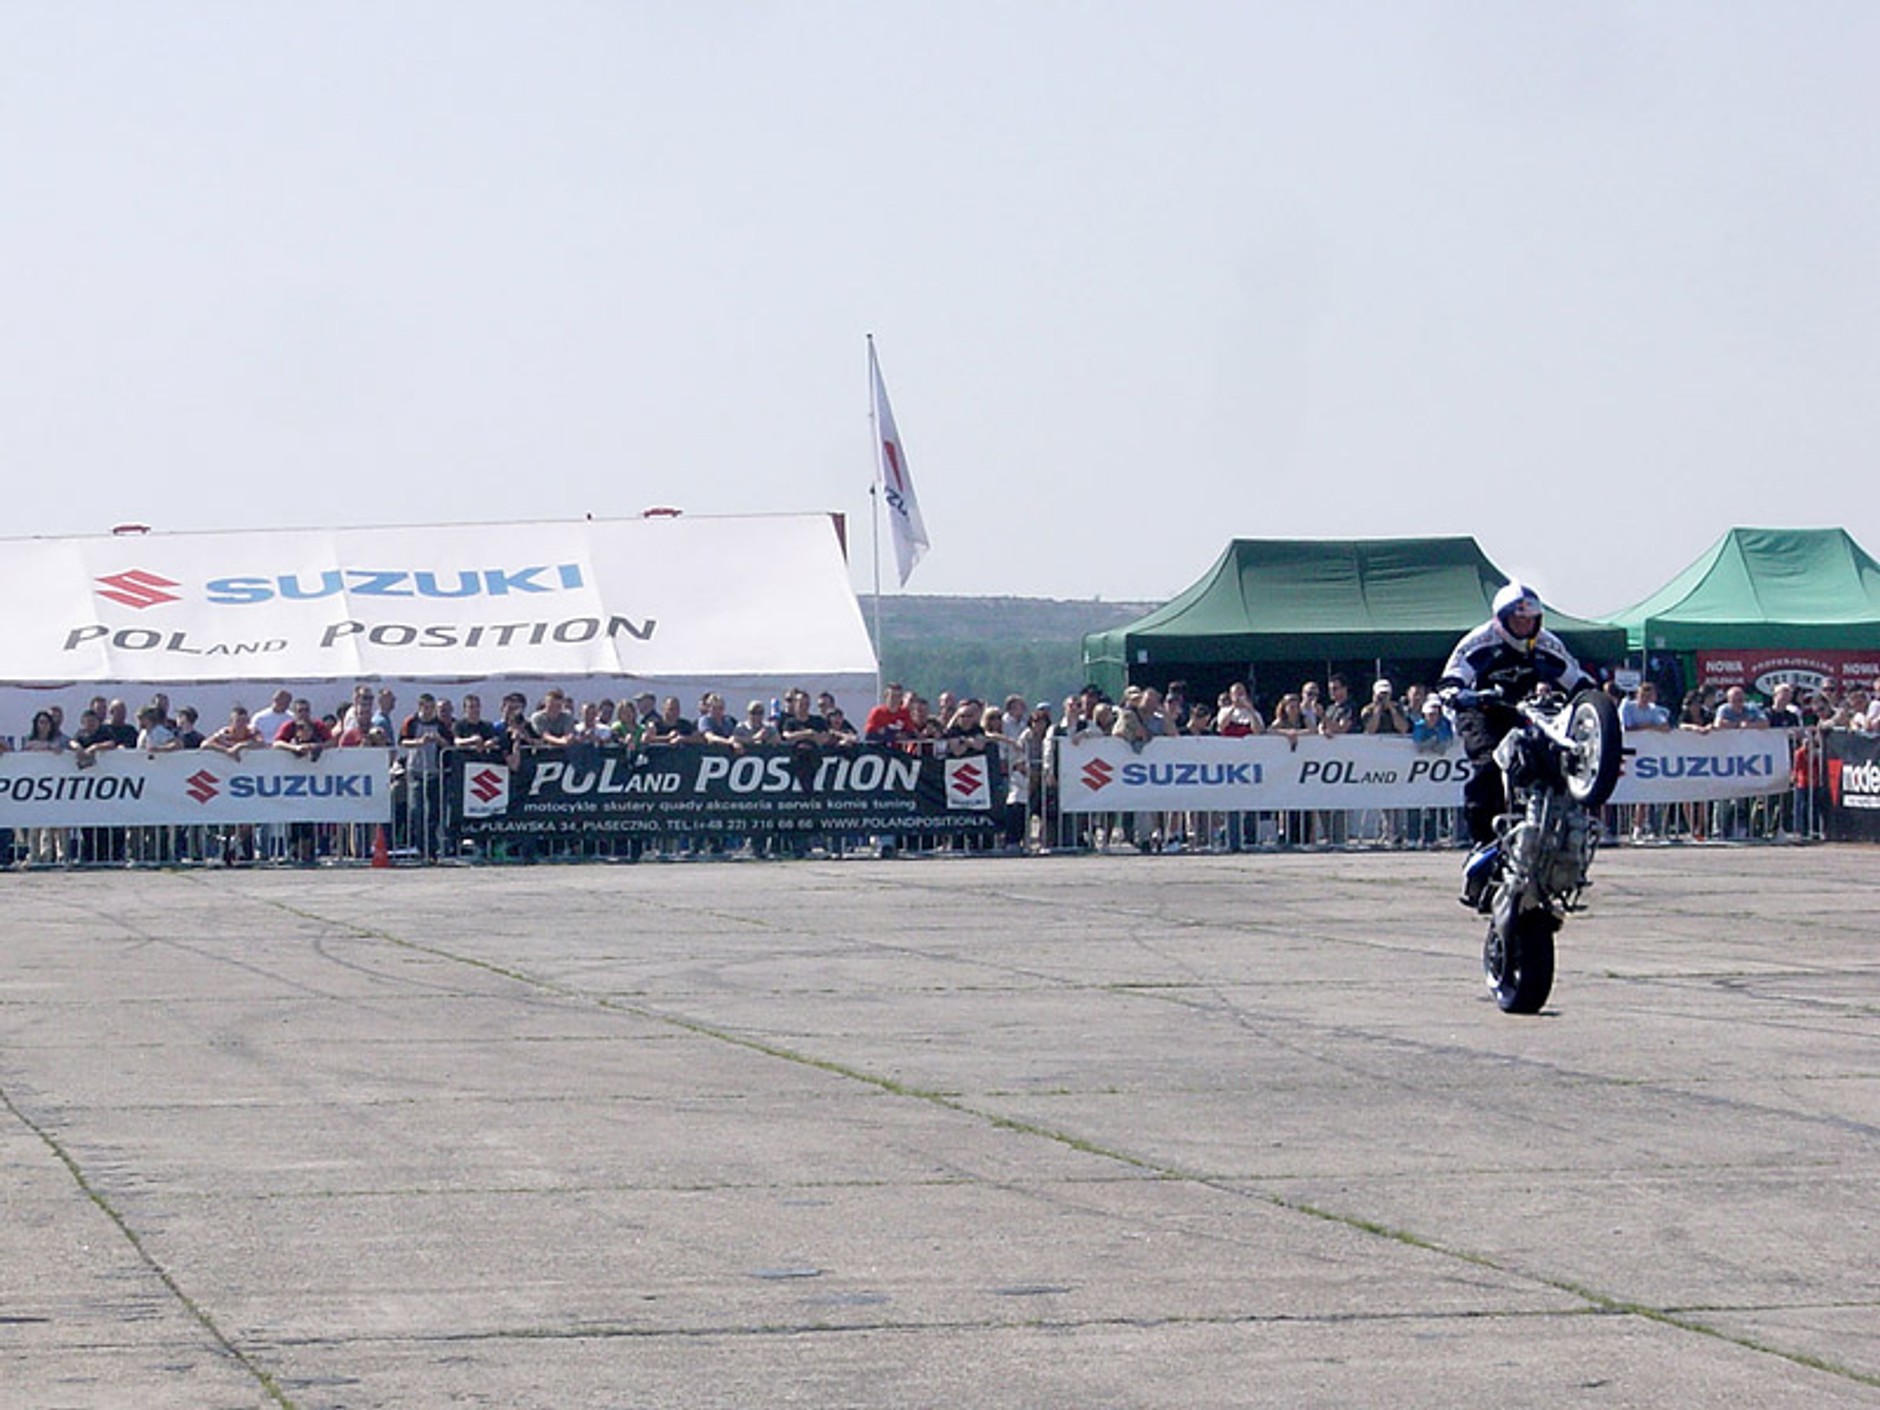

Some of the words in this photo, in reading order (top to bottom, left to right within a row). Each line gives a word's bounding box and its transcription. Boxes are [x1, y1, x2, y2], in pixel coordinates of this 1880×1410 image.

[206, 563, 584, 604] SUZUKI
[63, 625, 288, 655] POLAND
[320, 615, 657, 648] POSITION
[694, 753, 922, 793] POSTION
[1121, 762, 1264, 787] SUZUKI
[1299, 759, 1398, 785] POLAND
[1634, 753, 1774, 779] SUZUKI
[229, 774, 372, 799] SUZUKI
[524, 801, 598, 814] motocykle
[603, 801, 653, 813] skutery
[660, 800, 702, 813] quady
[706, 799, 772, 811] akcesoria
[777, 799, 821, 811] serwis
[827, 799, 868, 811] komis
[873, 798, 917, 812] tuning
